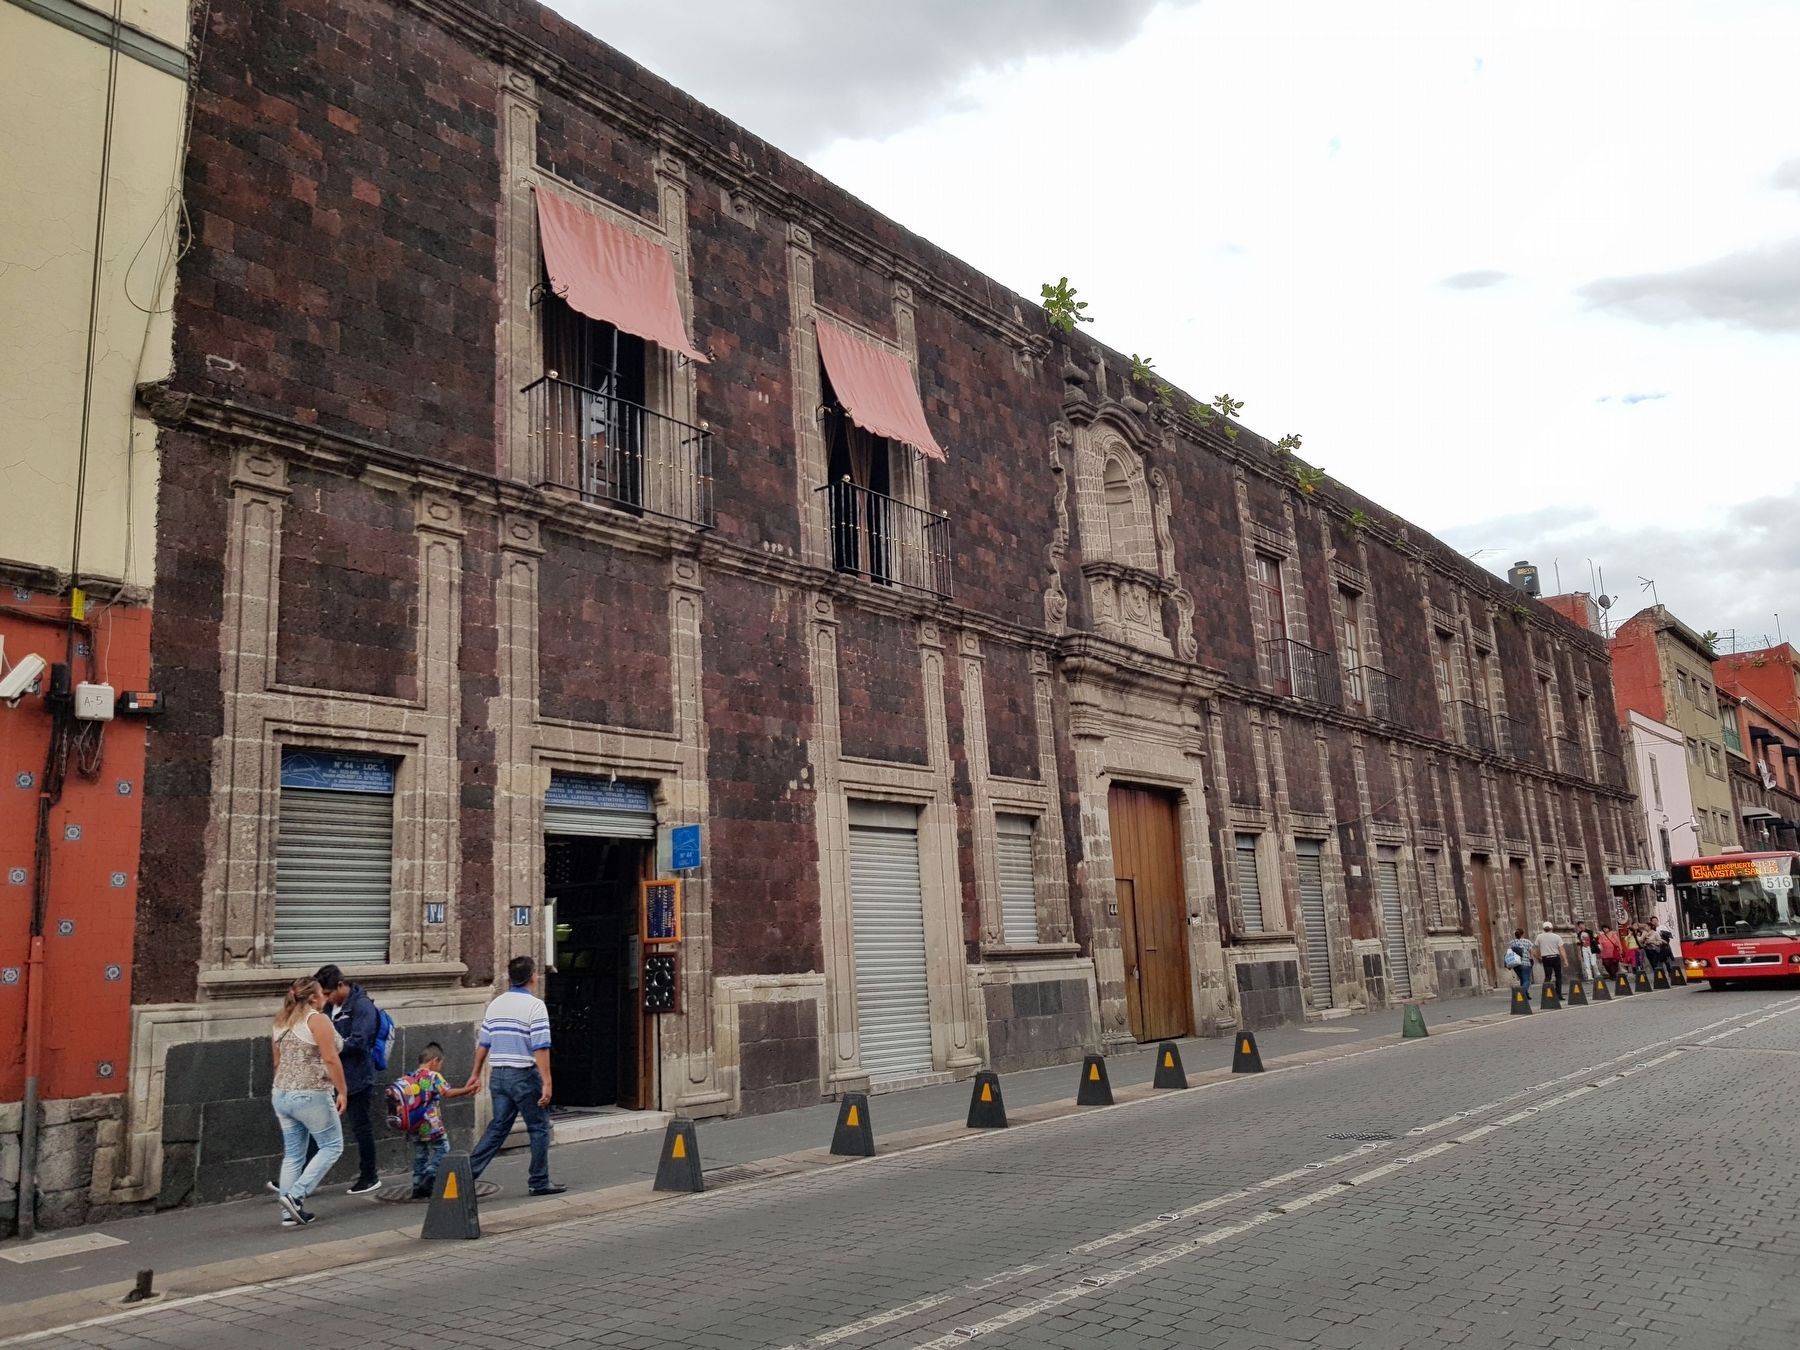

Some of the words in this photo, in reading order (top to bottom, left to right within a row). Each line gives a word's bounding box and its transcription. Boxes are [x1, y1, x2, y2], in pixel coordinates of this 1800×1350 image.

[84, 696, 103, 707] A-5
[1714, 862, 1755, 871] AEROPUERTO
[1767, 876, 1791, 888] 516
